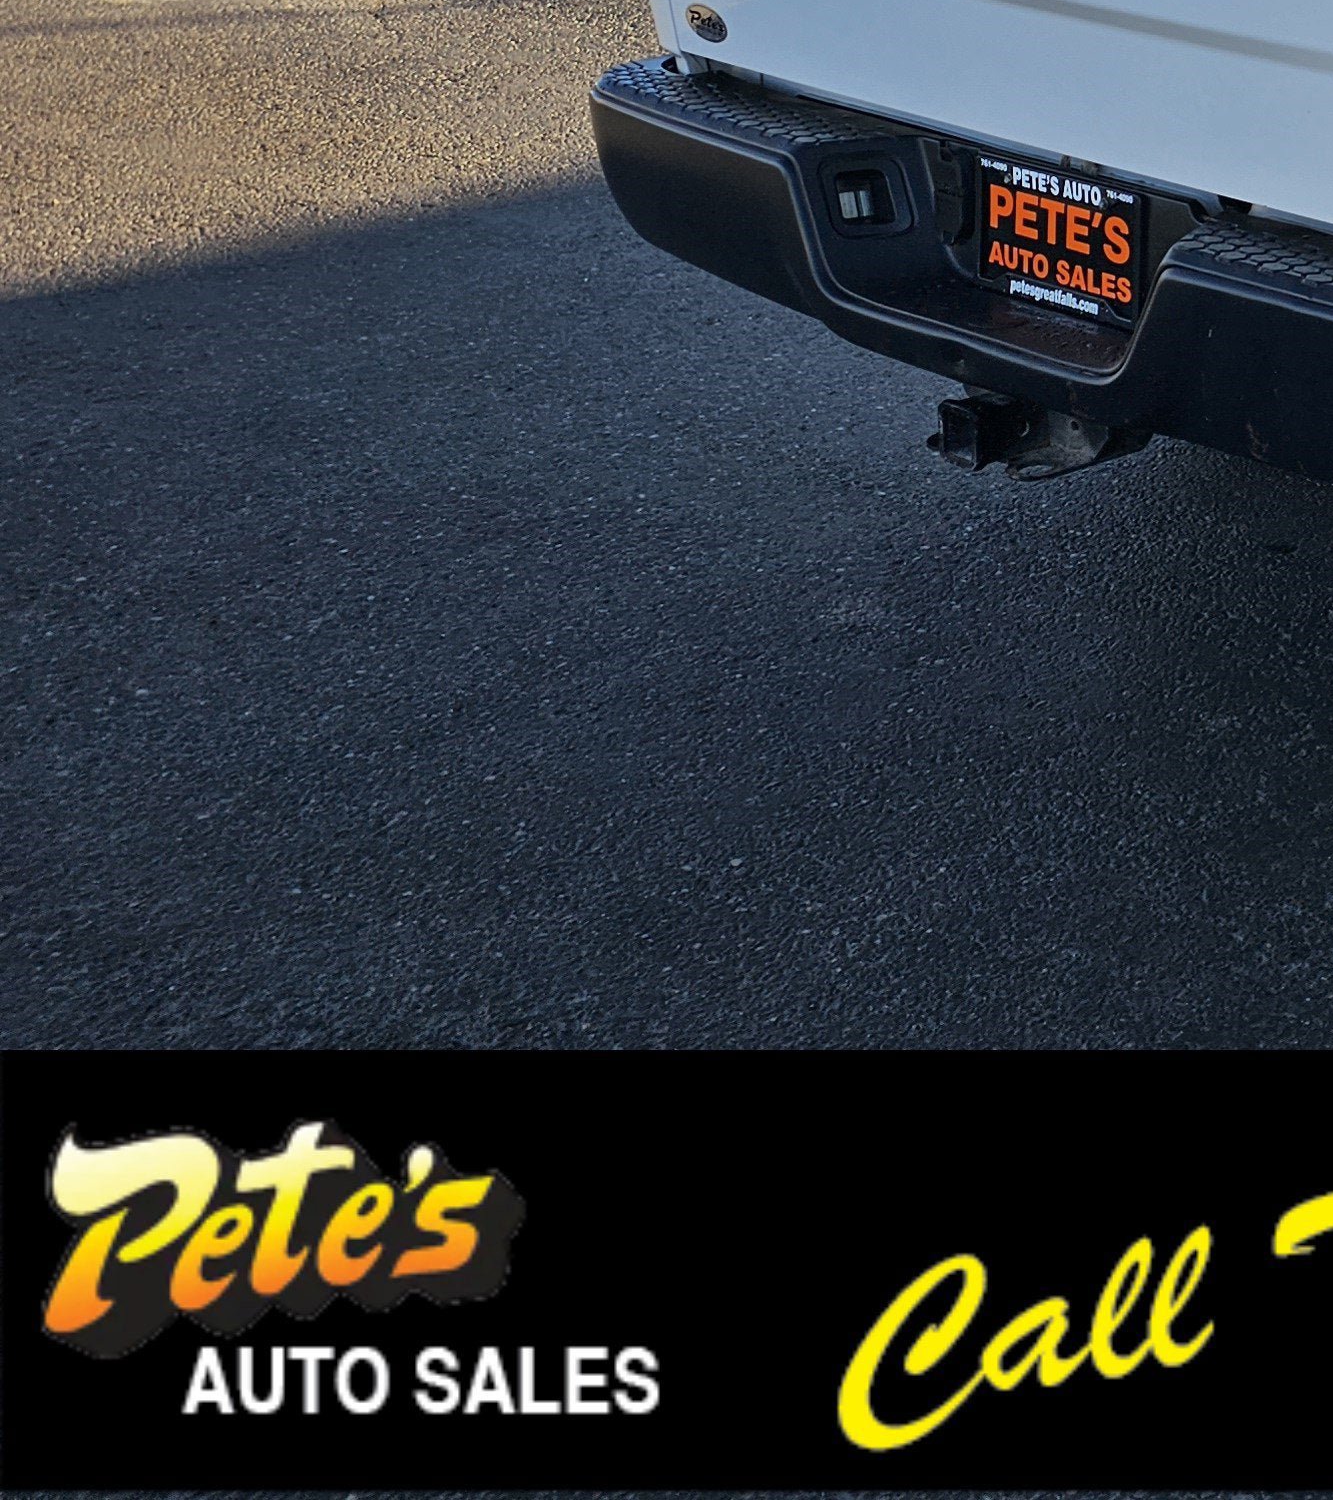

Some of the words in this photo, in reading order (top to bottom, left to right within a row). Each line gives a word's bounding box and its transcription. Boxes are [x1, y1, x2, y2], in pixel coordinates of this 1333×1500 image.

[1012, 166, 1060, 196] PETE'S
[1062, 179, 1101, 206] AUTO
[989, 183, 1130, 265] PETE'S
[988, 241, 1049, 279] AUTO
[1055, 259, 1133, 304] SALES
[1009, 279, 1100, 316] petesgreatfalls.com
